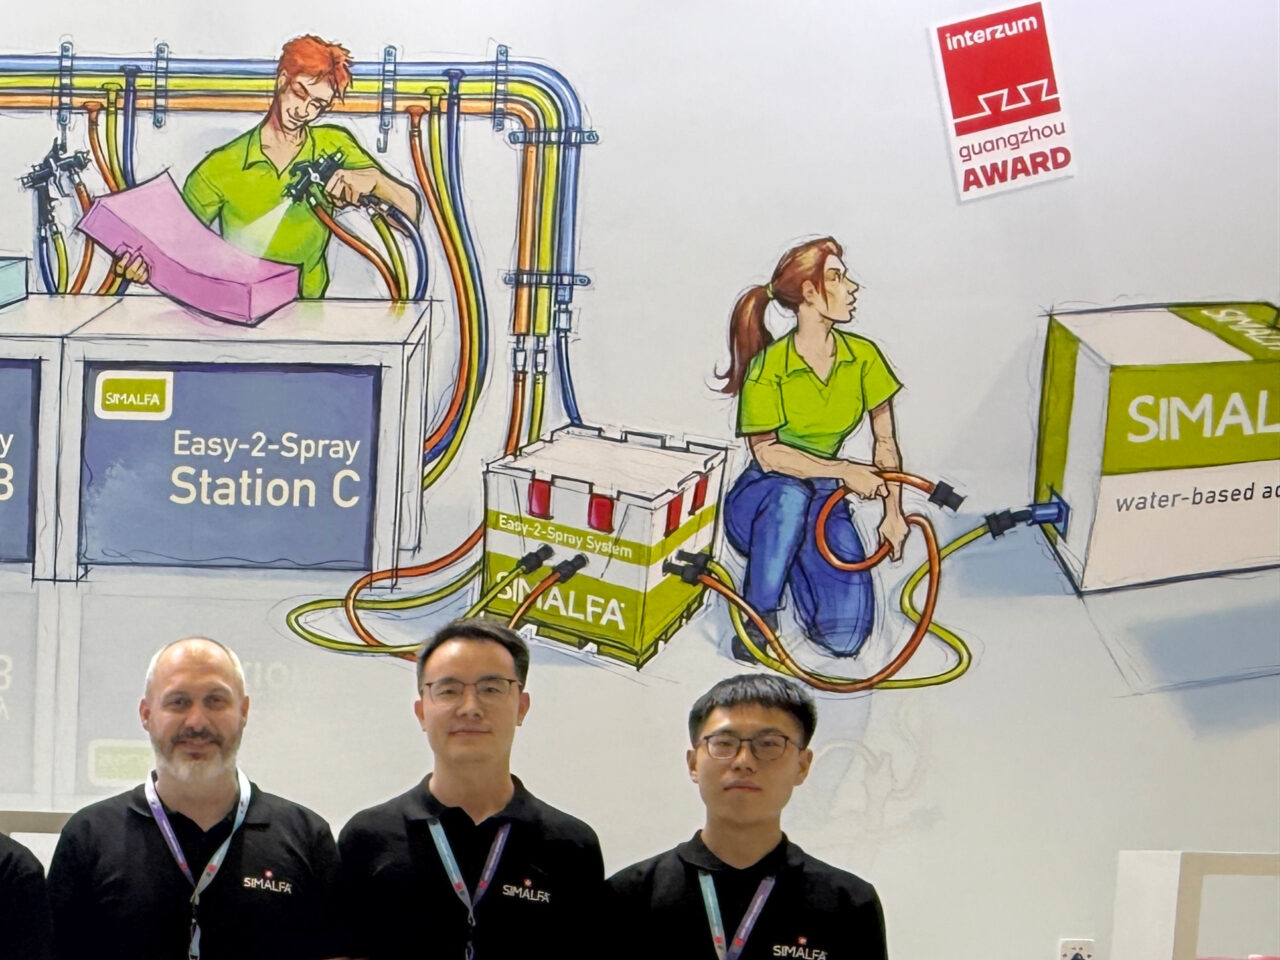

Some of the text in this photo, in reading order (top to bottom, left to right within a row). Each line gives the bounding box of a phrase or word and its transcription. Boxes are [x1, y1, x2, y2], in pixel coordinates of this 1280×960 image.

[945, 16, 1038, 51] interzum
[959, 122, 1066, 162] guangzhou
[963, 146, 1072, 192] AWARD
[105, 392, 160, 406] SIMALFA
[173, 430, 361, 464] Easy-2-Spray
[169, 465, 361, 508] Station C
[1116, 483, 1255, 512] water-based
[499, 515, 633, 559] Easy-2-Spray System
[243, 876, 293, 895] SIMALFA
[502, 884, 550, 903] SIMALFA
